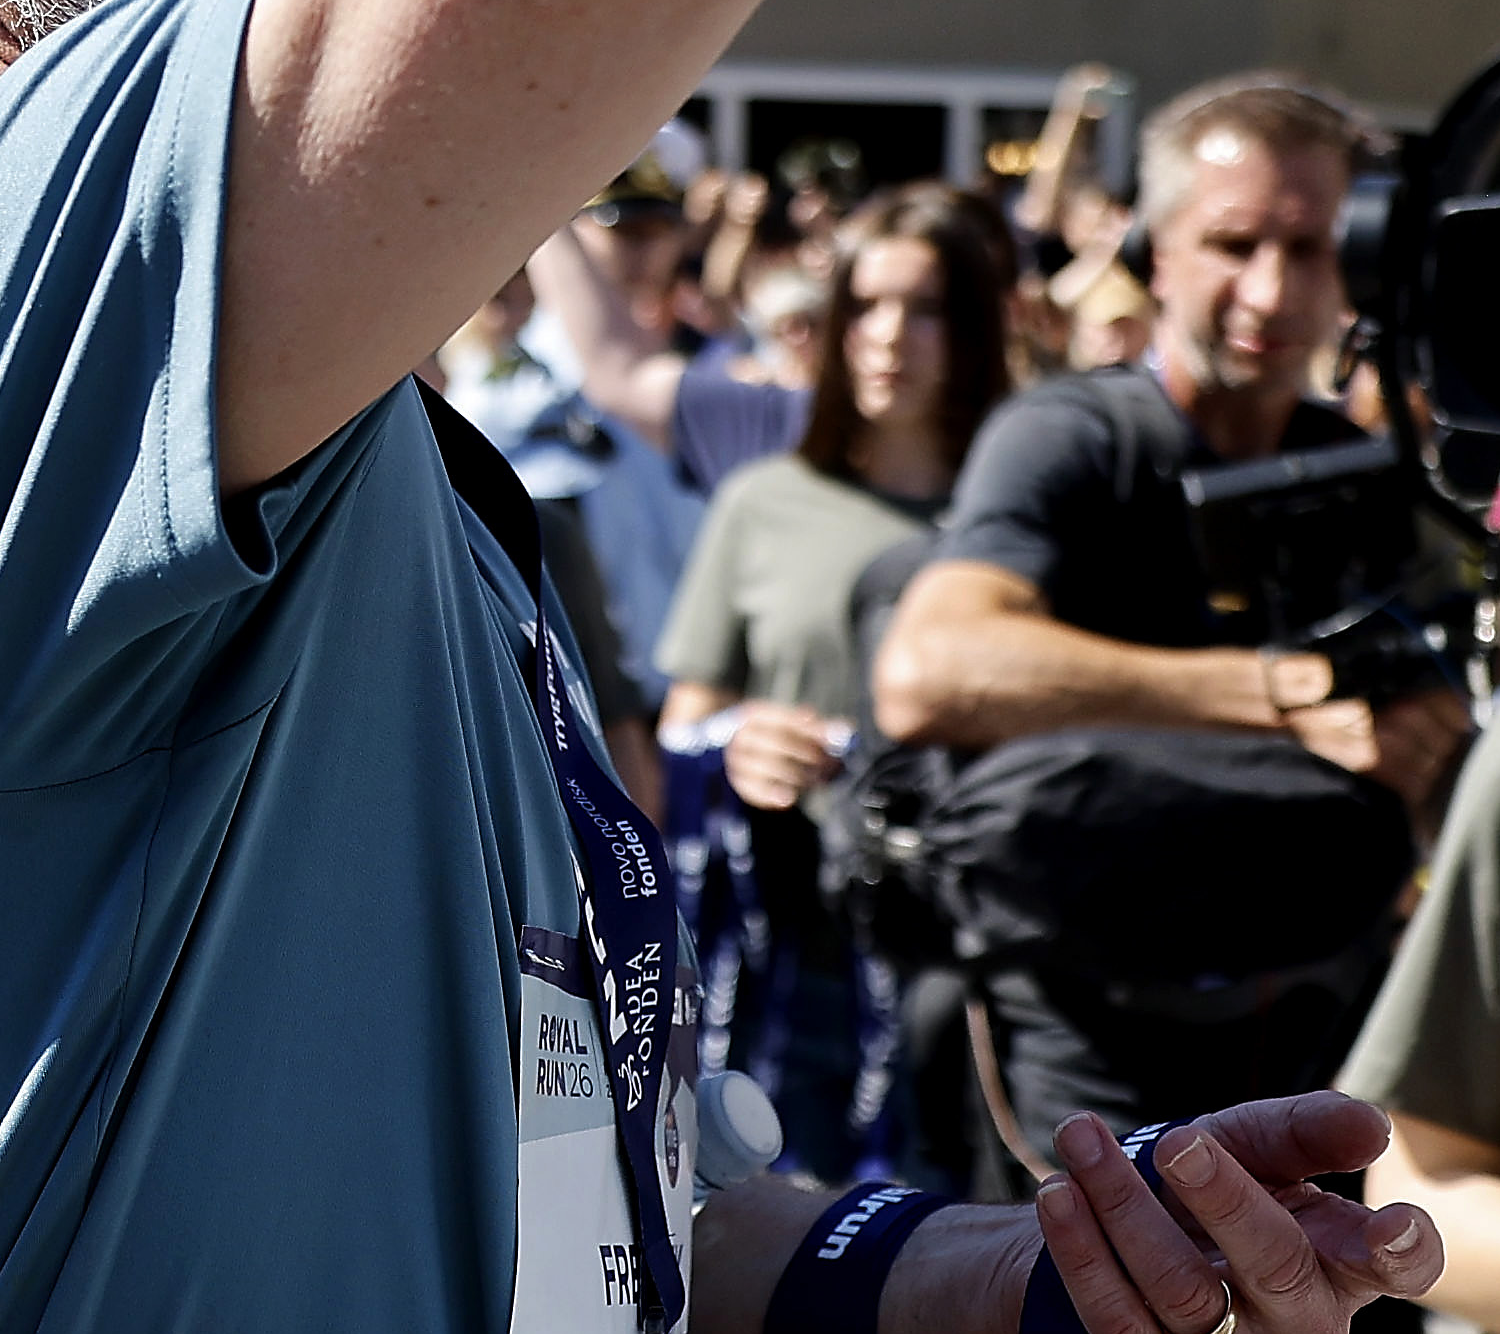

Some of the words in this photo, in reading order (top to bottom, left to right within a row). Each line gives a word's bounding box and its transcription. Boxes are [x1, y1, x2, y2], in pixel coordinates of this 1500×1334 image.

[565, 777, 618, 839] nordisk
[611, 841, 640, 900] novo
[616, 820, 658, 899] fonden
[538, 1013, 589, 1056] ROYAL
